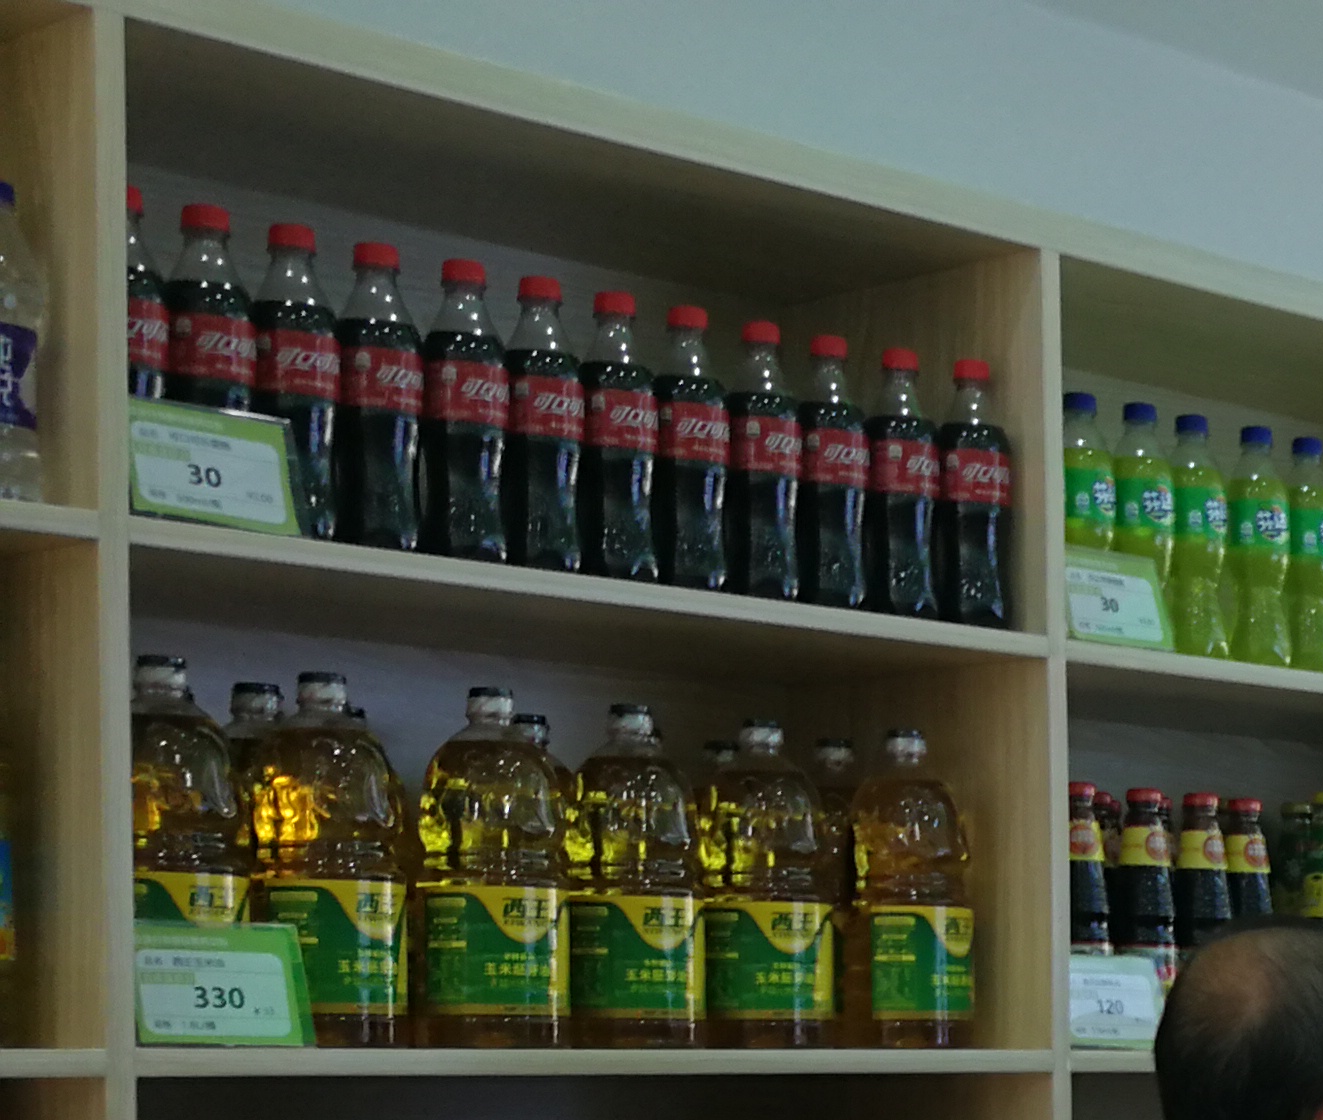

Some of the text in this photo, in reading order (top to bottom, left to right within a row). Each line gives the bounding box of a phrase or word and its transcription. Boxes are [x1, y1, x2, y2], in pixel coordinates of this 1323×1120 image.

[187, 463, 222, 489] 30
[502, 897, 550, 920] 西王
[643, 906, 690, 928] 西王
[193, 985, 245, 1010] 330
[1097, 999, 1125, 1015] 120
